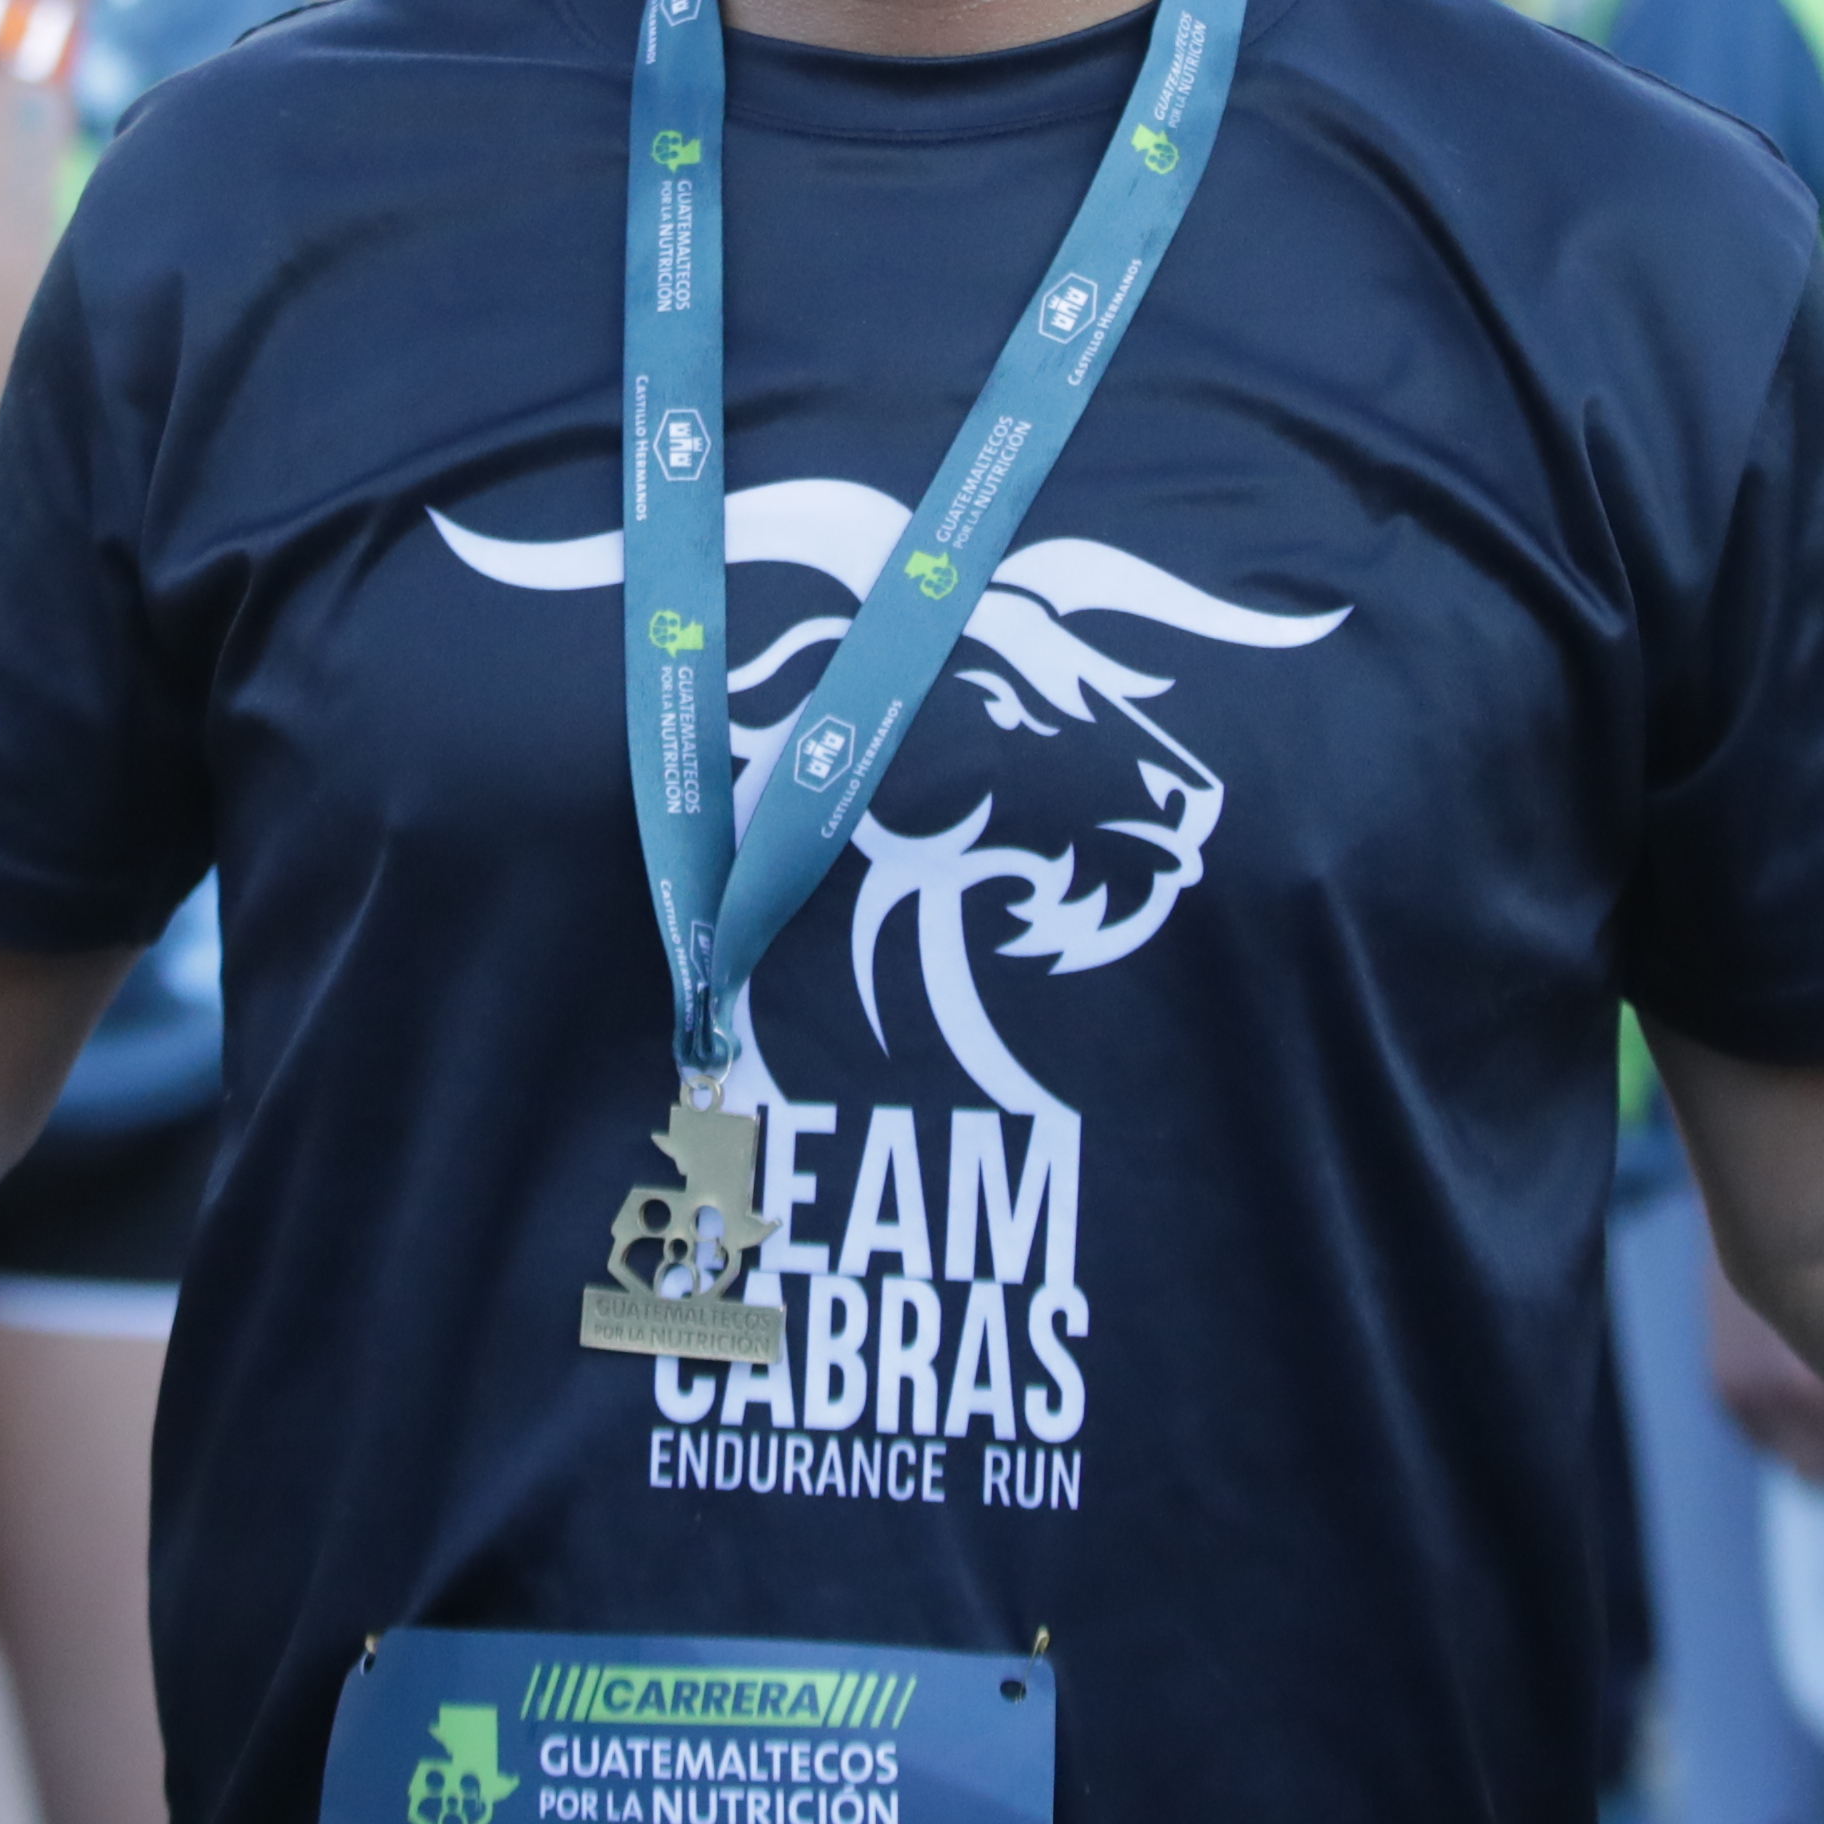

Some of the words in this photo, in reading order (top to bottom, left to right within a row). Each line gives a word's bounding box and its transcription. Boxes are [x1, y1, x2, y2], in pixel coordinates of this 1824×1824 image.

[1154, 10, 1192, 121] GUATEMALTECOS
[660, 180, 673, 205] POR
[660, 205, 672, 221] LA
[657, 224, 676, 313] NUTRICIÓN
[676, 179, 693, 311] GUATEMALTECOS
[1067, 330, 1105, 386] CASTILLO
[1096, 258, 1143, 329] HERMANOS
[635, 375, 649, 437] CASTILLO
[635, 440, 649, 522] HERMANOS
[935, 415, 1014, 543] GUATEMALTECOS
[952, 524, 973, 550] POR
[967, 509, 983, 526] LA
[661, 666, 673, 692] POR
[661, 693, 673, 710] LA
[660, 712, 684, 815] NUTRICIÓN
[678, 665, 701, 815] GUATEMALTECOS
[820, 778, 861, 839] CASTILLO
[852, 698, 903, 778] HERMANOS
[696, 1102, 1082, 1286] EAM
[594, 1324, 623, 1341] POR
[627, 1327, 645, 1342] LA
[649, 1327, 770, 1355] NUTRICIÓN
[595, 1297, 771, 1330] GUATEMALTECOS
[649, 1426, 947, 1502] ENDURANCE
[981, 1444, 1082, 1510] RUN
[602, 1678, 821, 1719] CARRERA
[539, 1734, 899, 1784] GUATEMALTECOS
[539, 1787, 597, 1821] POR
[606, 1790, 643, 1822] LA
[652, 1782, 899, 1824] NUTRICIÓN
